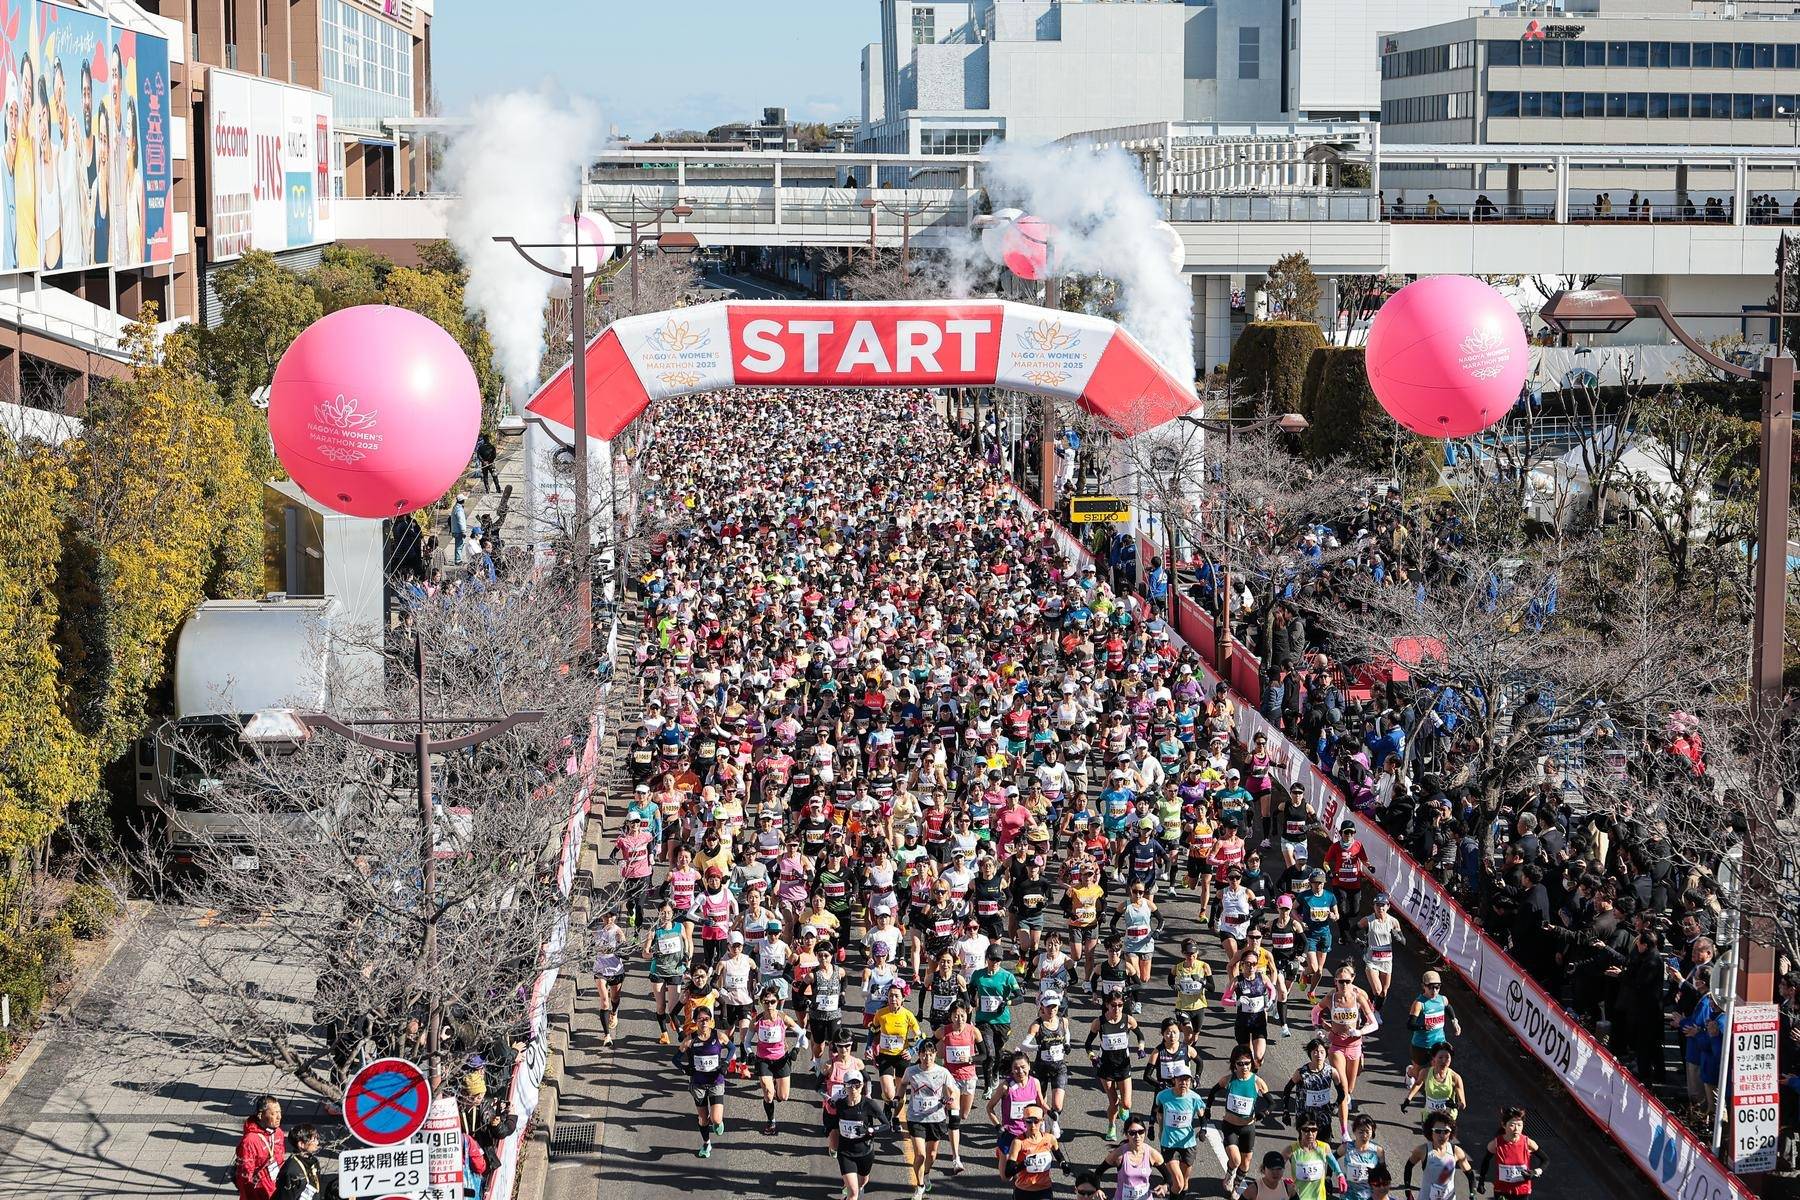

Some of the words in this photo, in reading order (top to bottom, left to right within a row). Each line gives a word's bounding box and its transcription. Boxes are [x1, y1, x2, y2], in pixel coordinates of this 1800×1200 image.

[1546, 24, 1586, 32] MITSUBISHI
[1546, 31, 1580, 39] ELECTRIC
[215, 110, 248, 157] docomo
[740, 318, 991, 374] START
[642, 353, 677, 361] NAGOYA
[679, 352, 720, 360] WOMEN'S
[1011, 352, 1046, 360] NAGOYA
[1048, 352, 1088, 360] WOMEN'S
[1459, 353, 1486, 363] NAGOYA
[646, 361, 694, 370] MARATHON
[696, 361, 717, 369] 2025
[1014, 361, 1061, 369] MARATHON
[1063, 361, 1084, 369] 2025
[1462, 359, 1497, 370] MARATHON
[307, 422, 340, 436] NAGOYA
[341, 430, 383, 441] WOMEN'S
[310, 433, 356, 448] MARATHON
[356, 441, 379, 450] 2025
[1083, 513, 1119, 522] SEIKO
[1333, 1011, 1357, 1021] A10356
[1523, 998, 1571, 1074] TOYOTA
[1740, 1062, 1773, 1071] これより先
[1232, 1099, 1248, 1108] 154
[1738, 1108, 1776, 1123] 06:00
[1739, 1135, 1776, 1150] 16:20
[343, 1149, 424, 1173] 野球開催日
[1302, 1165, 1317, 1174] 135
